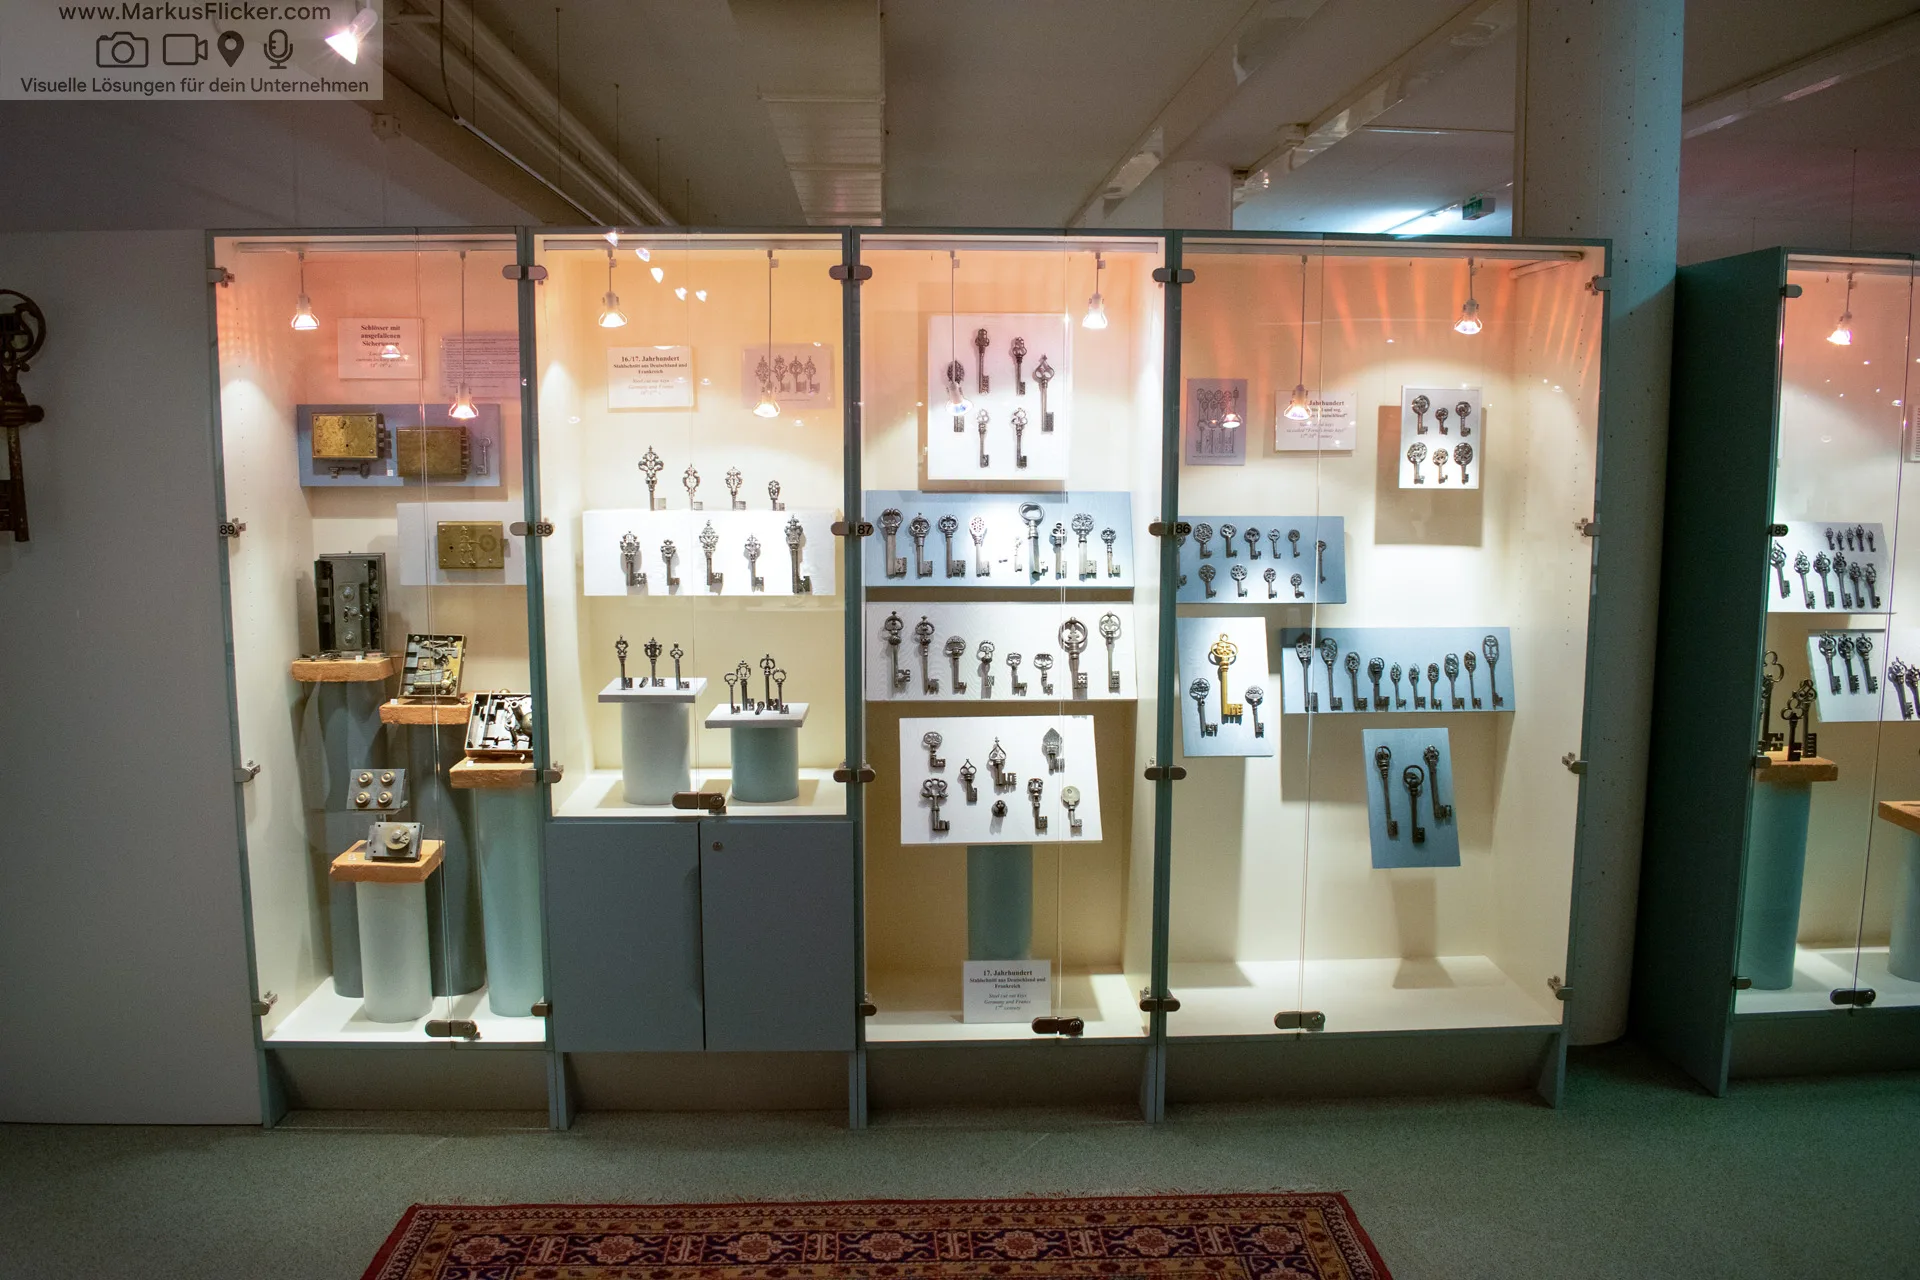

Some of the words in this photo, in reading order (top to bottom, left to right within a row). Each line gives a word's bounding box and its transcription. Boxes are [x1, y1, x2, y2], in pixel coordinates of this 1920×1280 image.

[220, 524, 235, 535] 89
[536, 524, 551, 535] 88
[857, 524, 873, 535] 87
[1175, 523, 1191, 534] 86
[1775, 525, 1787, 535] 85
